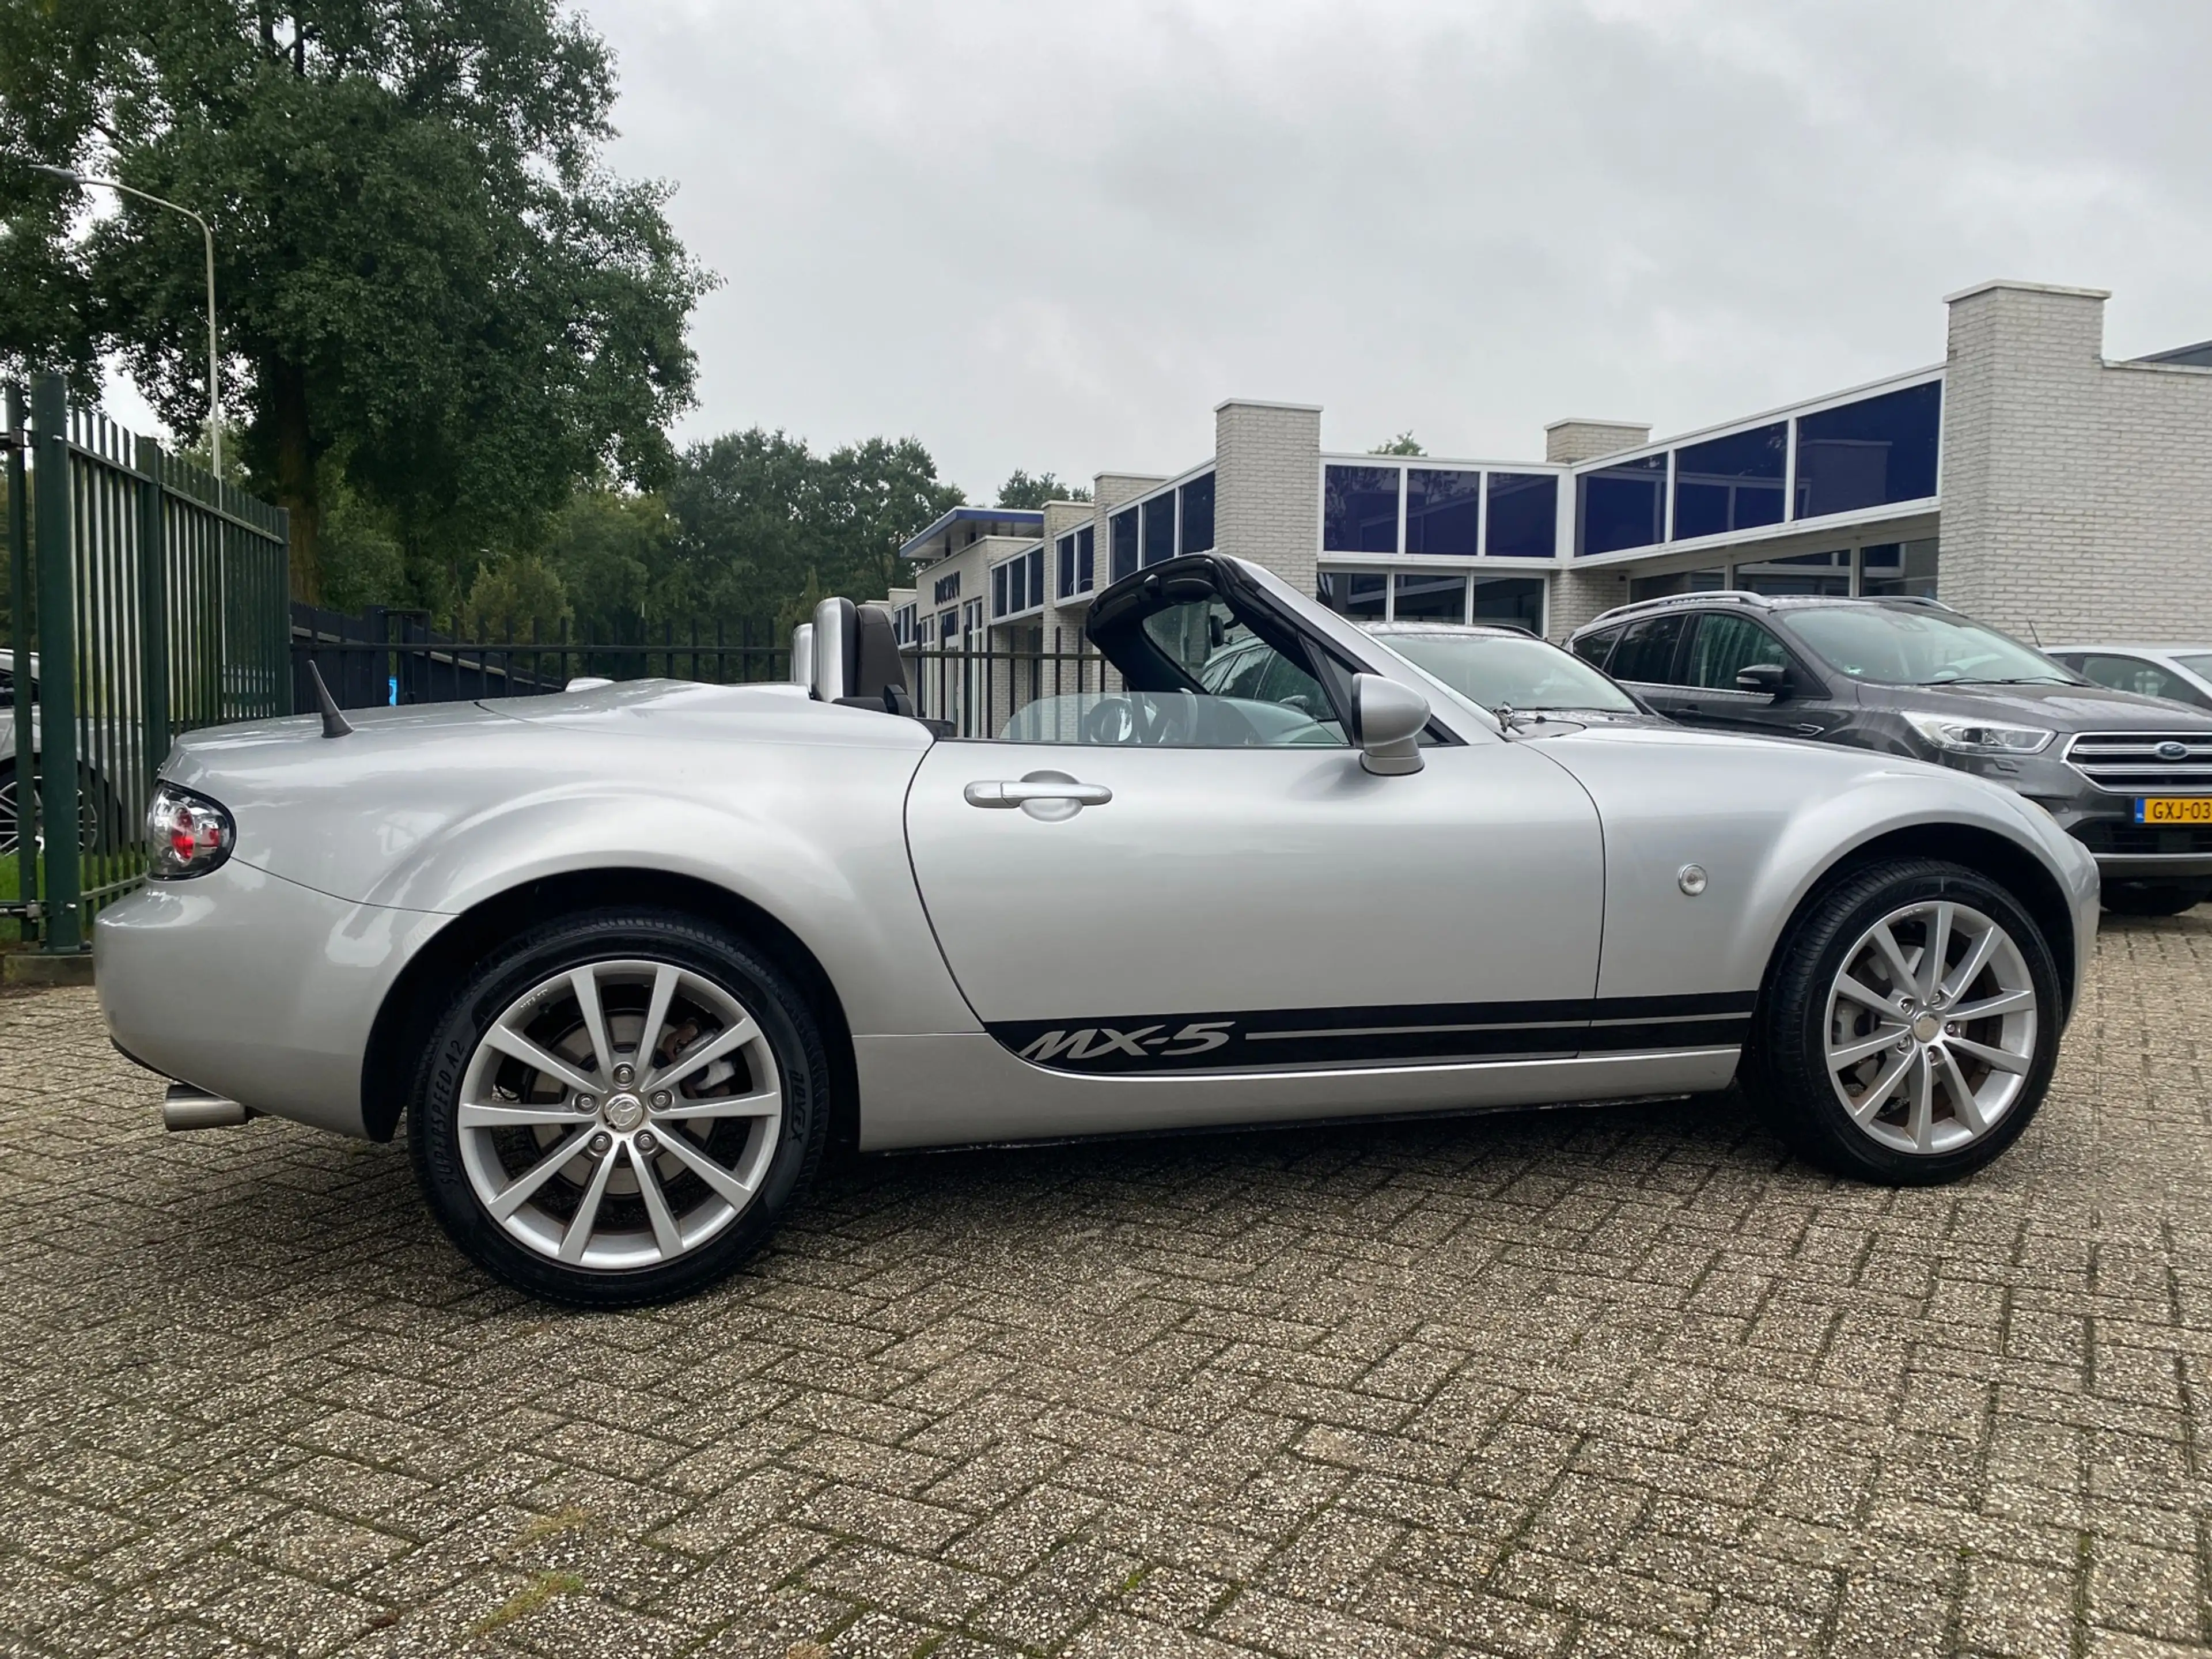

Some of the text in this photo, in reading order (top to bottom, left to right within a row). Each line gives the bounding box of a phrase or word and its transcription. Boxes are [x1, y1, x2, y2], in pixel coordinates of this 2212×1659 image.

[2153, 801, 2211, 820] GXJ-03
[445, 1040, 465, 1069] A2
[1016, 1021, 1237, 1060] MX-5
